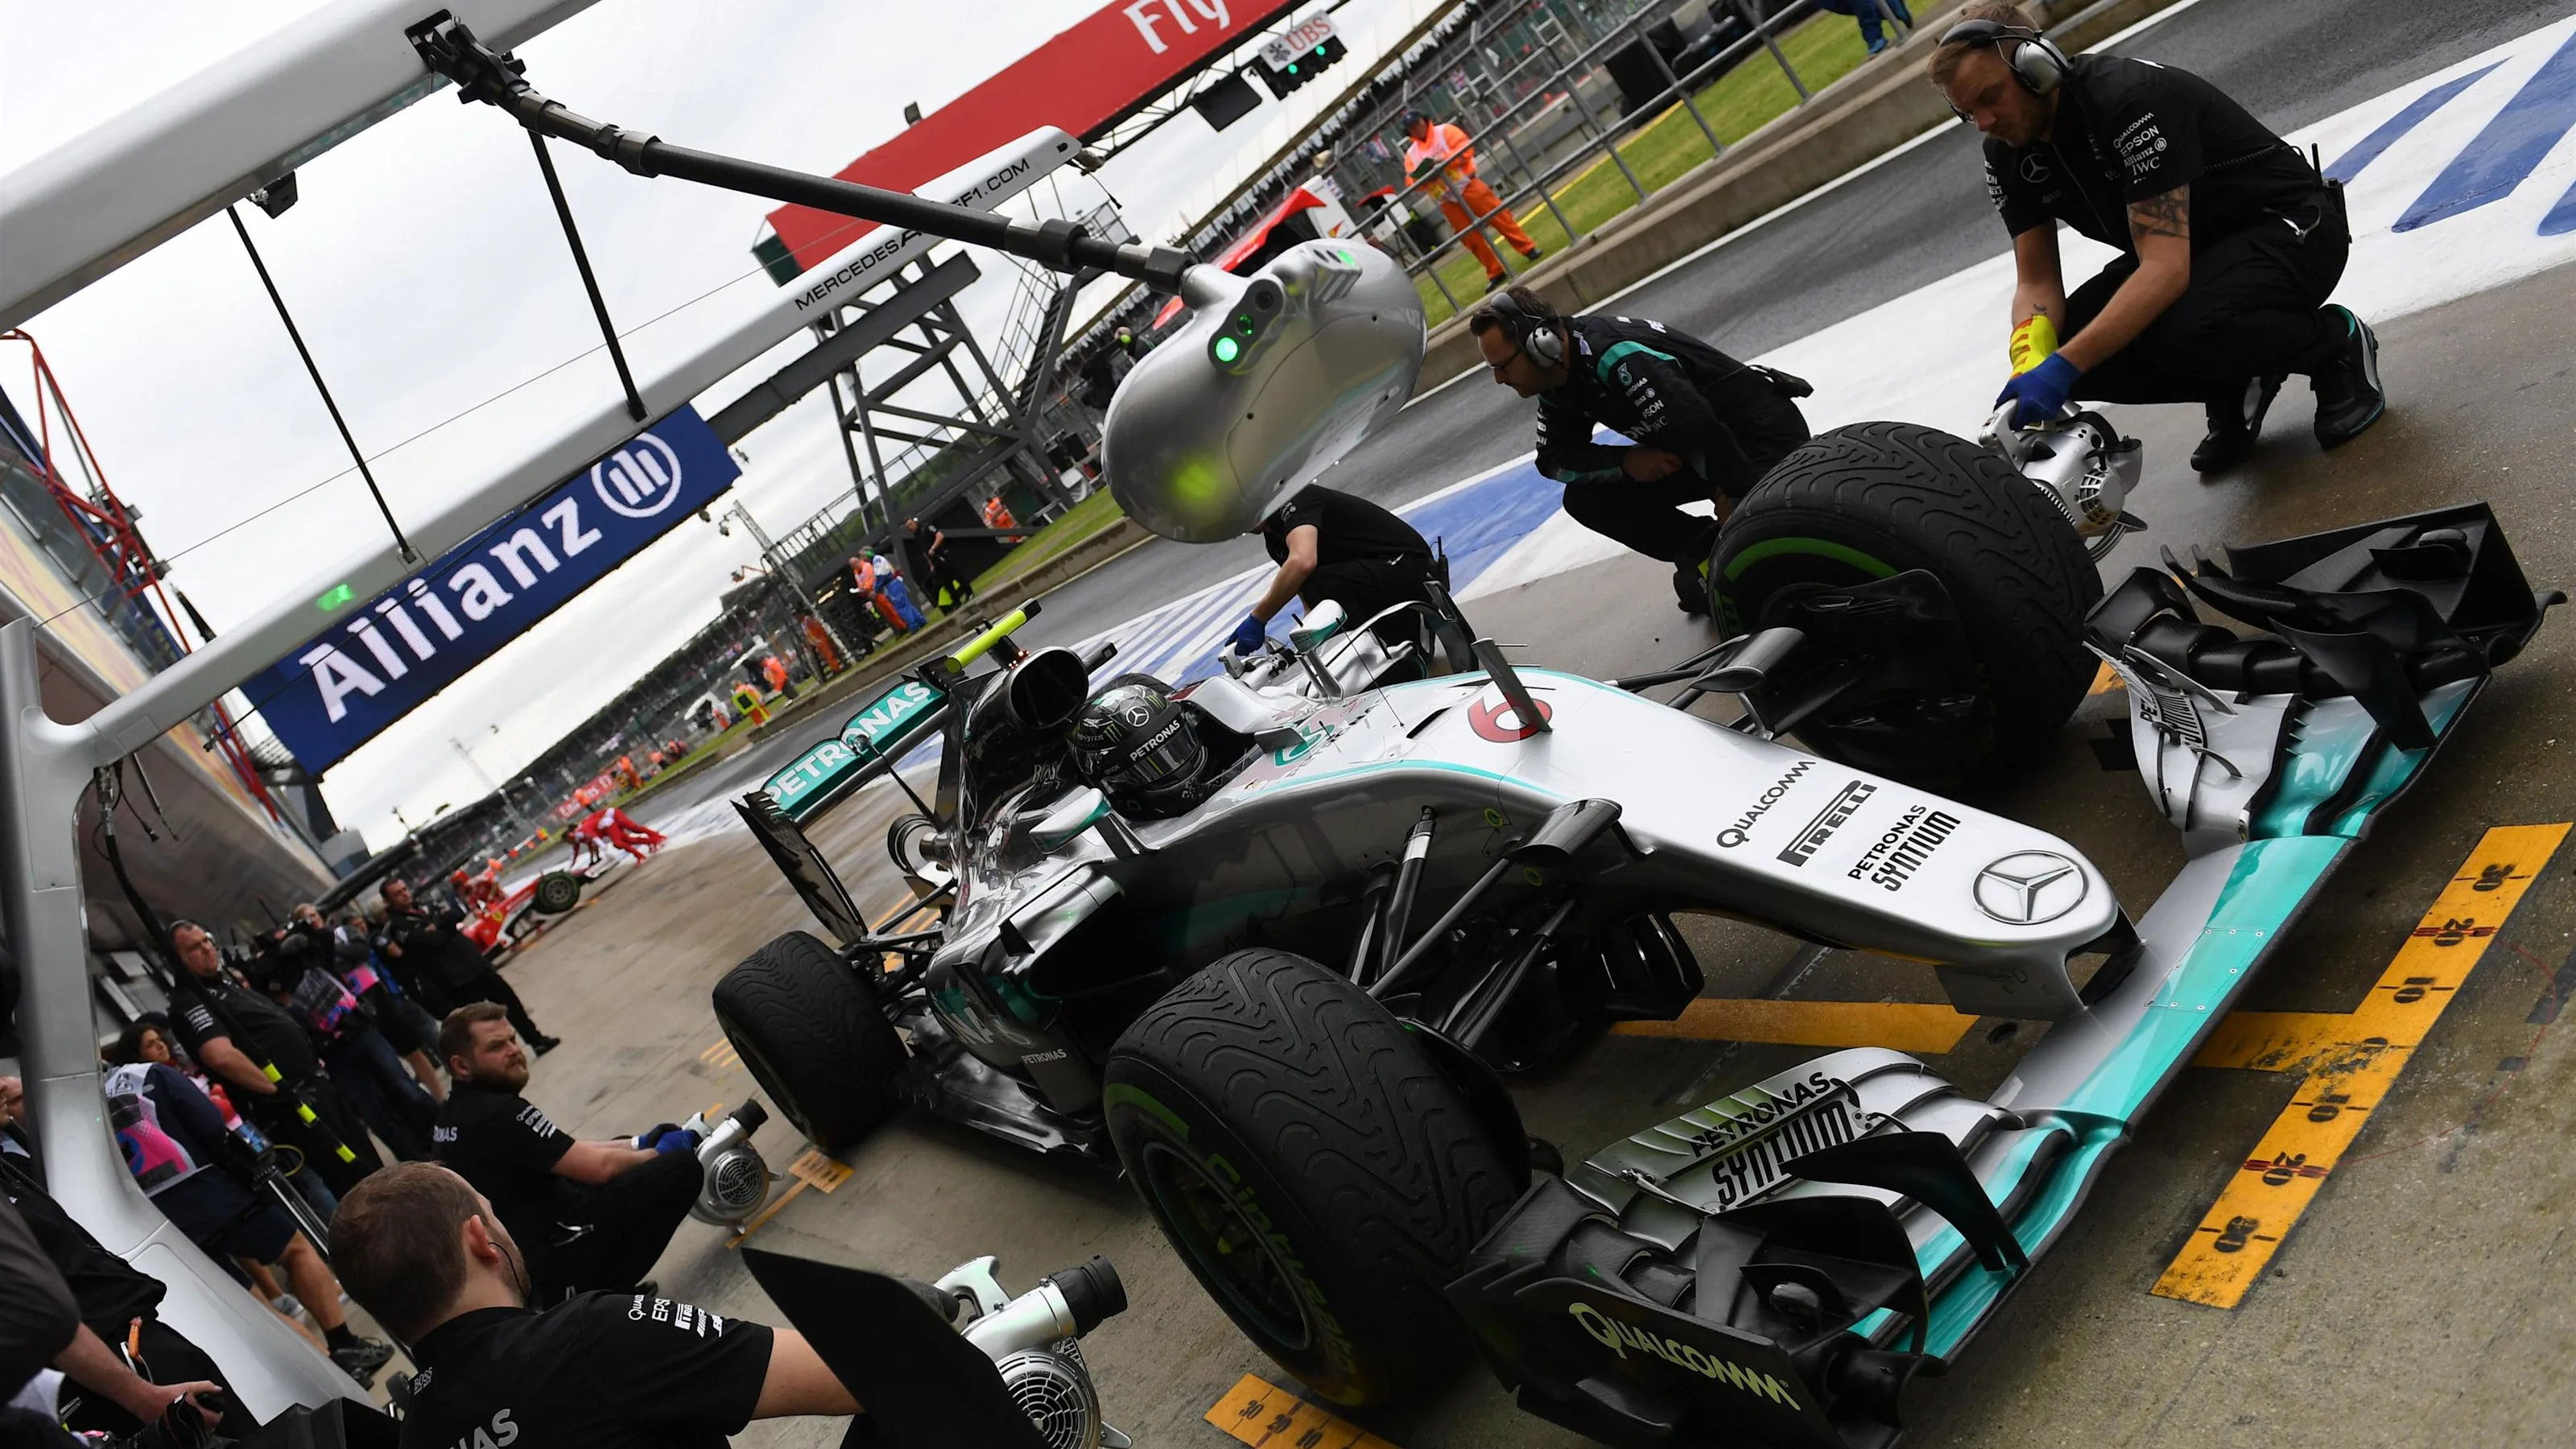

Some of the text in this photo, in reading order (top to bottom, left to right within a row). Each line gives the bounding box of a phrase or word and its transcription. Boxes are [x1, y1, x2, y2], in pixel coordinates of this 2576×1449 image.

[1122, 0, 1231, 55] Fly
[1286, 16, 1331, 52] UBS
[2120, 125, 2160, 157] EPSON
[2123, 146, 2154, 167] Allianz
[2132, 156, 2161, 176] IWC
[299, 496, 603, 724] Allianz
[1129, 720, 1181, 762] PETRONAS
[1467, 692, 1554, 744] 6
[1716, 761, 1816, 848] QUALCOMM
[1776, 780, 1878, 867] PIRELLI
[1847, 804, 1927, 880] PETRONAS
[1871, 811, 1961, 891] SYNTIUM
[1021, 1049, 1067, 1064] PETRONAS
[1690, 1071, 1831, 1158] PETRONAS
[1569, 1302, 1801, 1410] QUALCOMM
